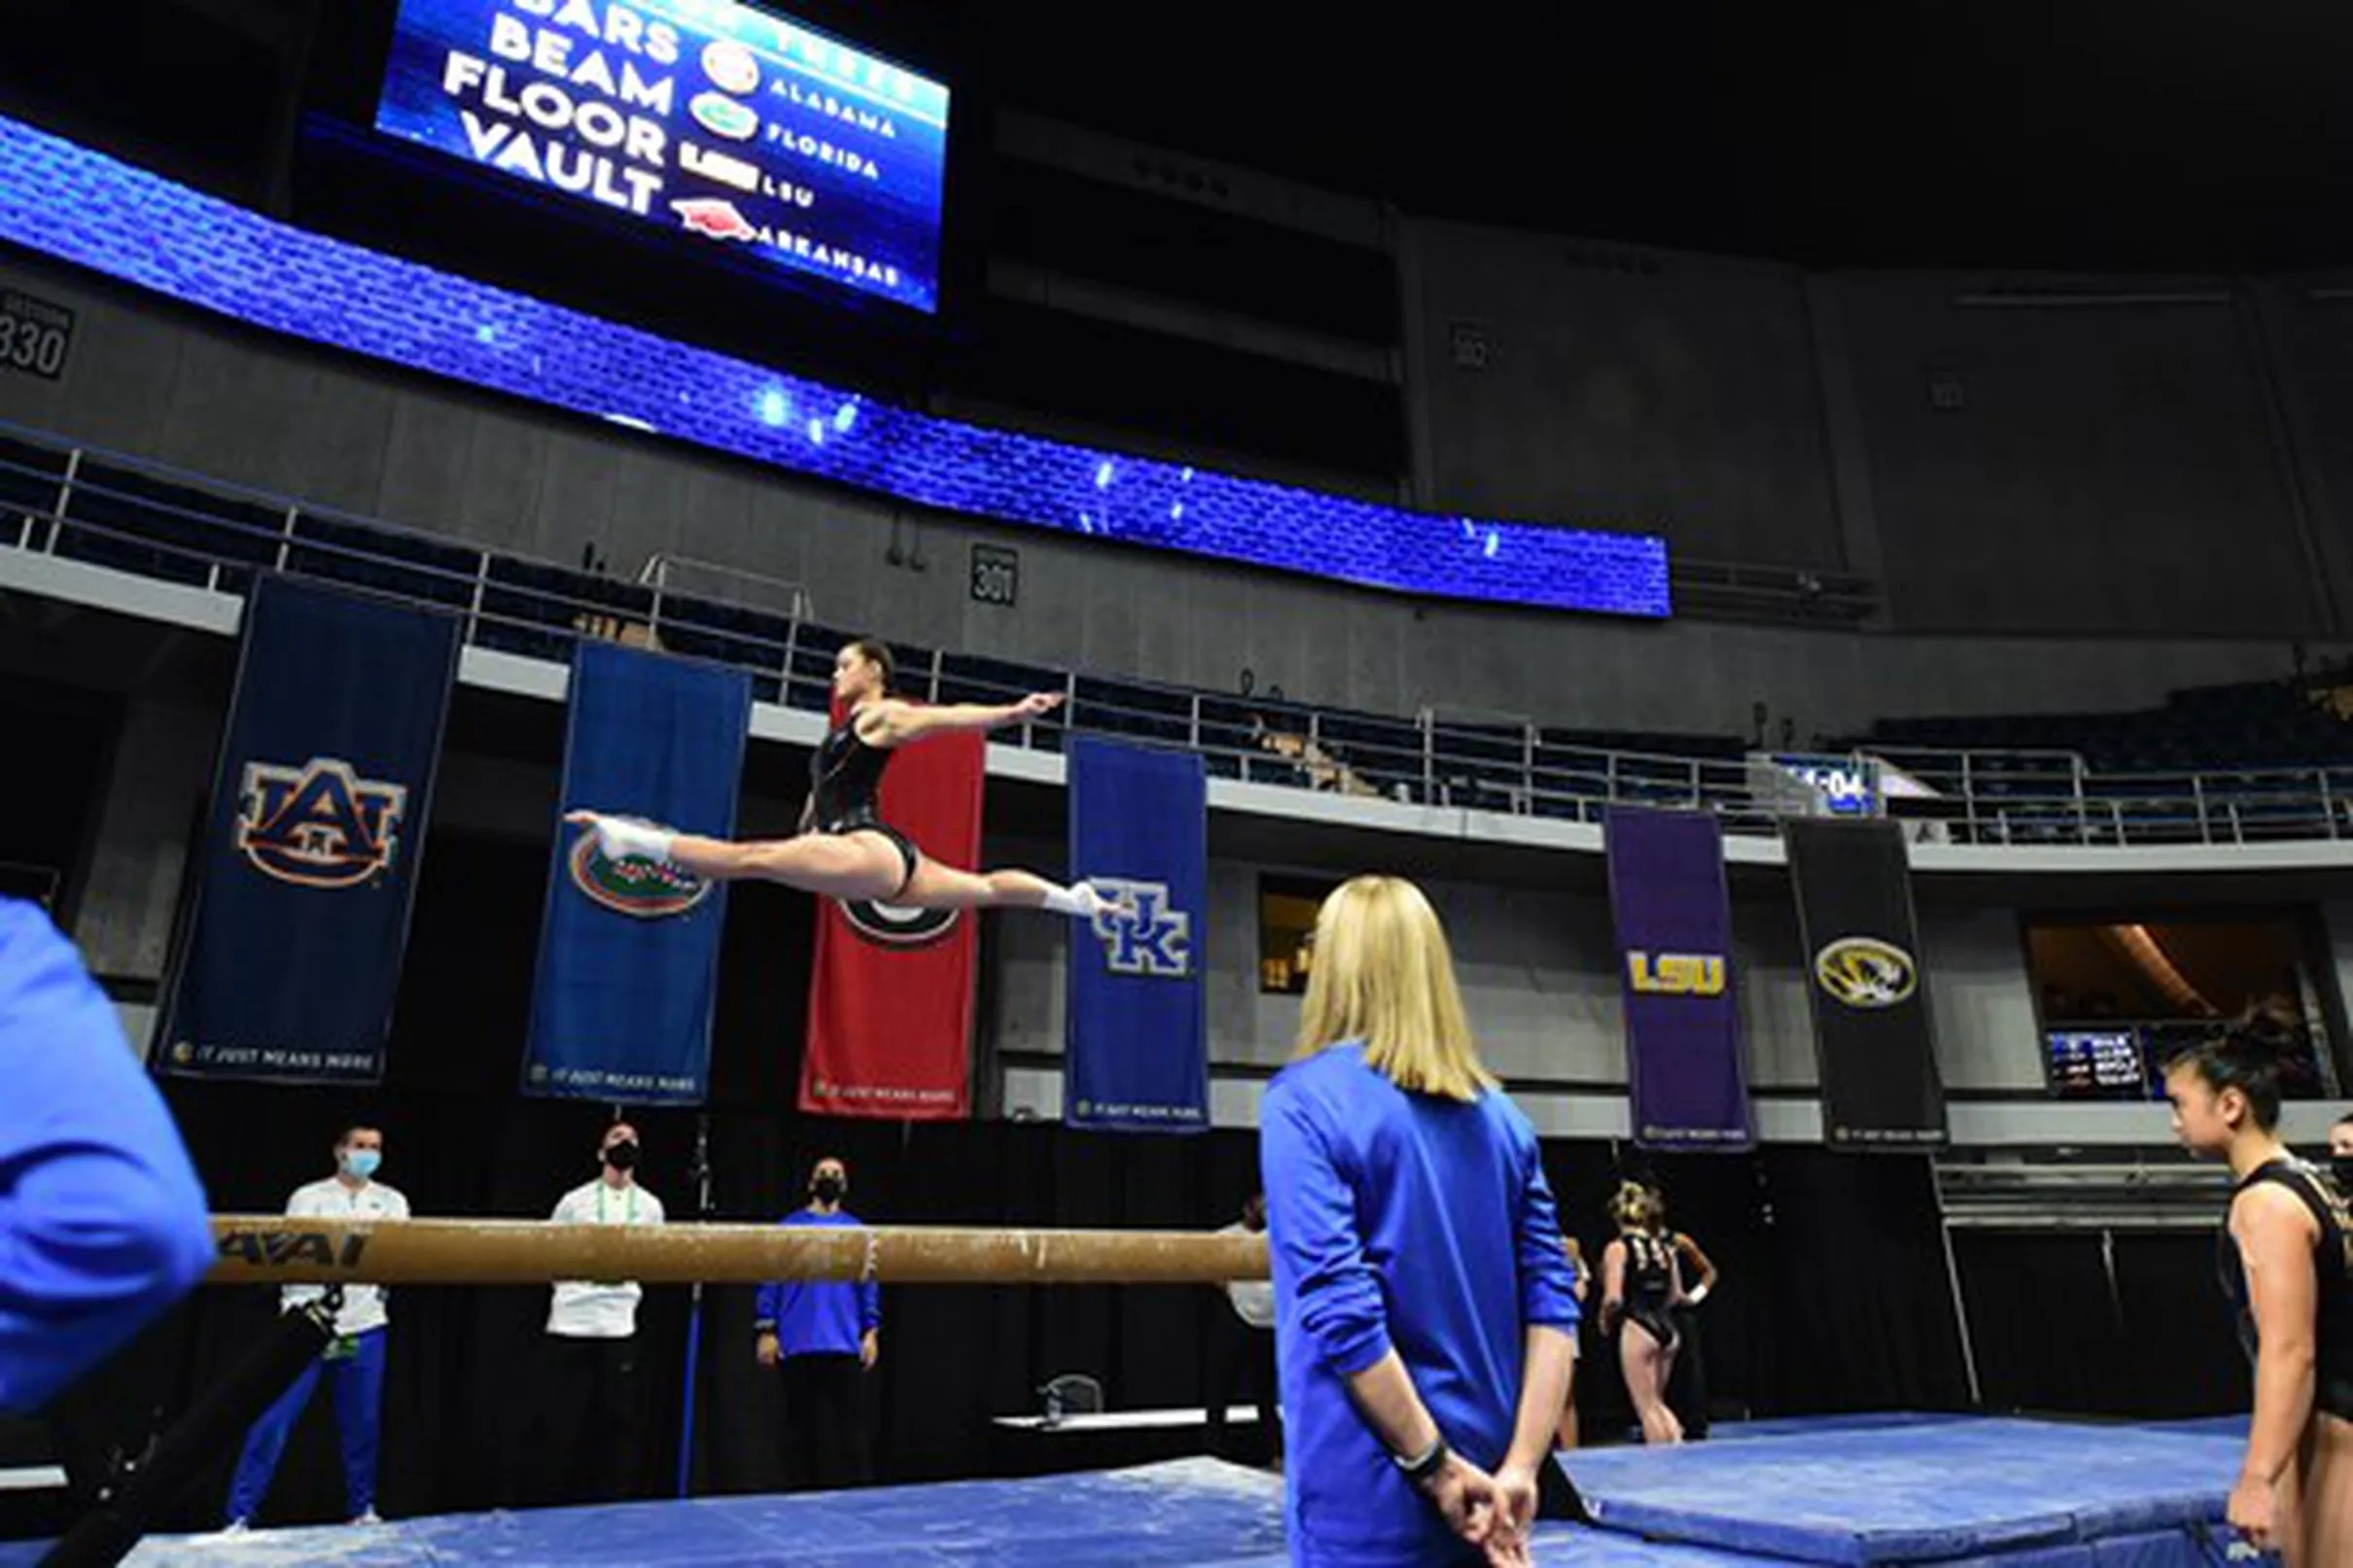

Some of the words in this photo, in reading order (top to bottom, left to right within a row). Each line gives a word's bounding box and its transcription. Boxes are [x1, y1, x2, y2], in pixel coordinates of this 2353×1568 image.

[490, 12, 673, 116] BEAM
[443, 51, 666, 165] FLOOR
[769, 79, 896, 138] ALABAMA
[460, 110, 664, 216] VAULT
[766, 122, 879, 180] FLORIDA
[762, 176, 814, 207] LSU
[757, 226, 899, 286] ARKANSAS
[0, 314, 65, 373] 330
[1628, 950, 1725, 995] LSU
